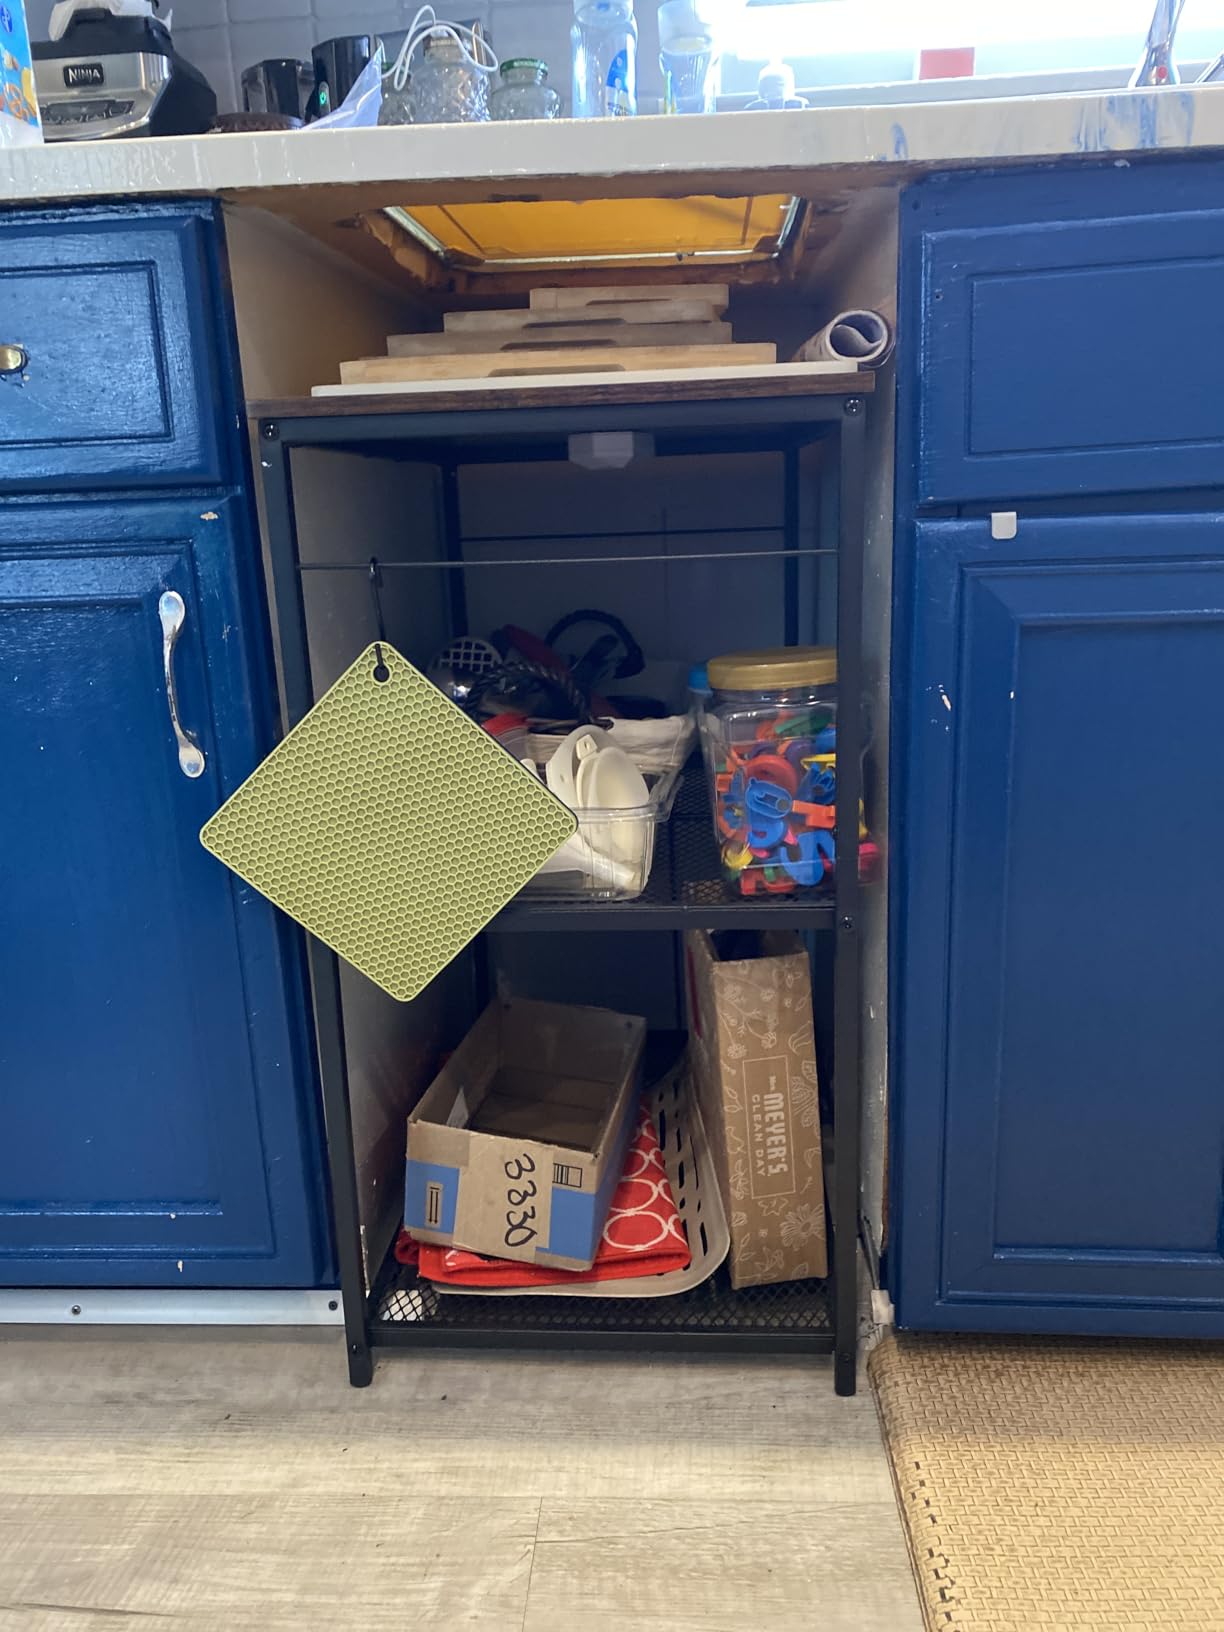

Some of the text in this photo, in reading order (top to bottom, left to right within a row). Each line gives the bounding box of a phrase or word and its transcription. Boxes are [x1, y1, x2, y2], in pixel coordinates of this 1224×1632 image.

[68, 67, 101, 83] NINJA
[752, 1094, 766, 1176] CLEAN DAY
[763, 1093, 788, 1175] MEYER'S
[504, 1153, 538, 1247] 3330
